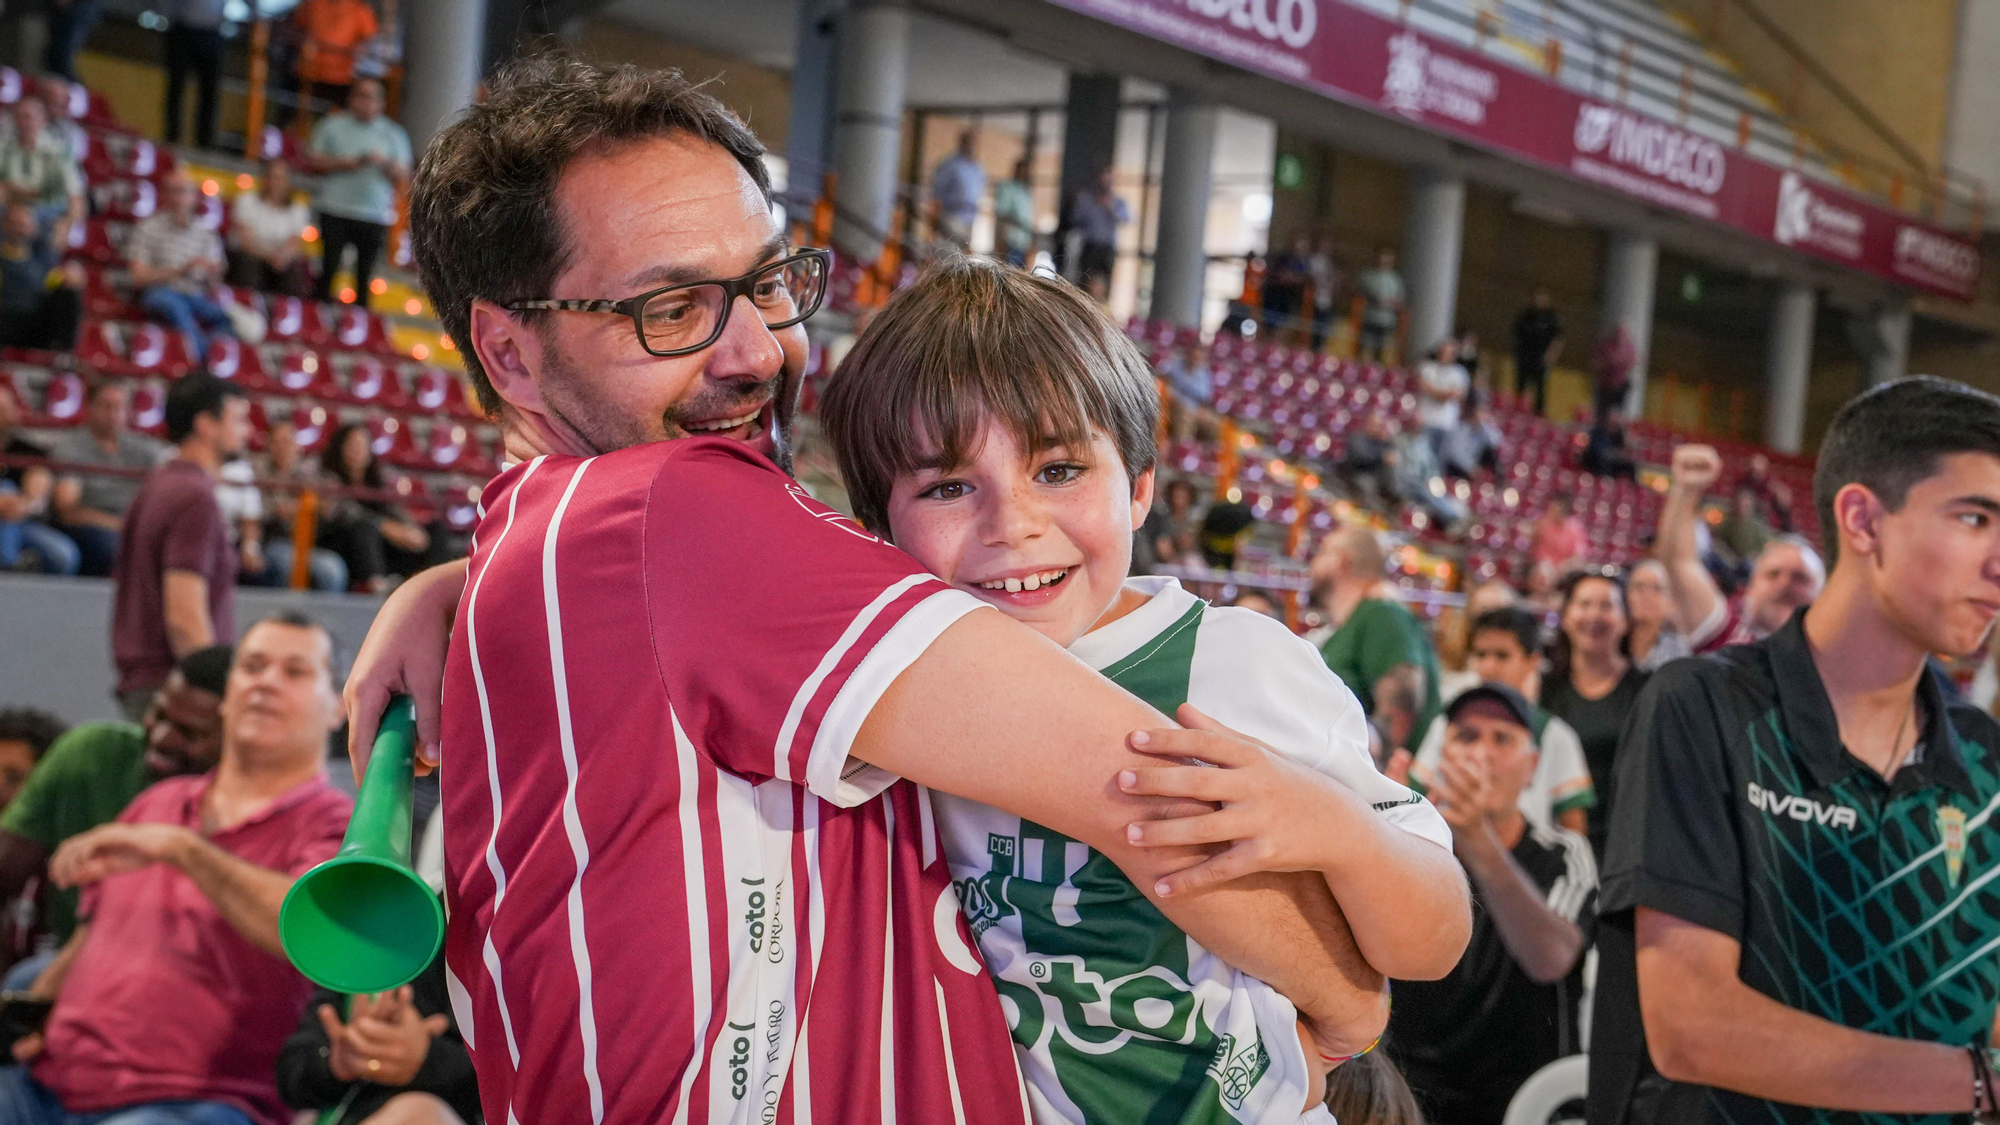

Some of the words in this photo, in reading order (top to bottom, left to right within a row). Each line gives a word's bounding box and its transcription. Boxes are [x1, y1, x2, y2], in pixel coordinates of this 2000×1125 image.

[1747, 781, 1857, 831] GIVOVA
[990, 836, 1014, 856] CCB
[998, 961, 1196, 1051] oto
[763, 1072, 779, 1090] Y
